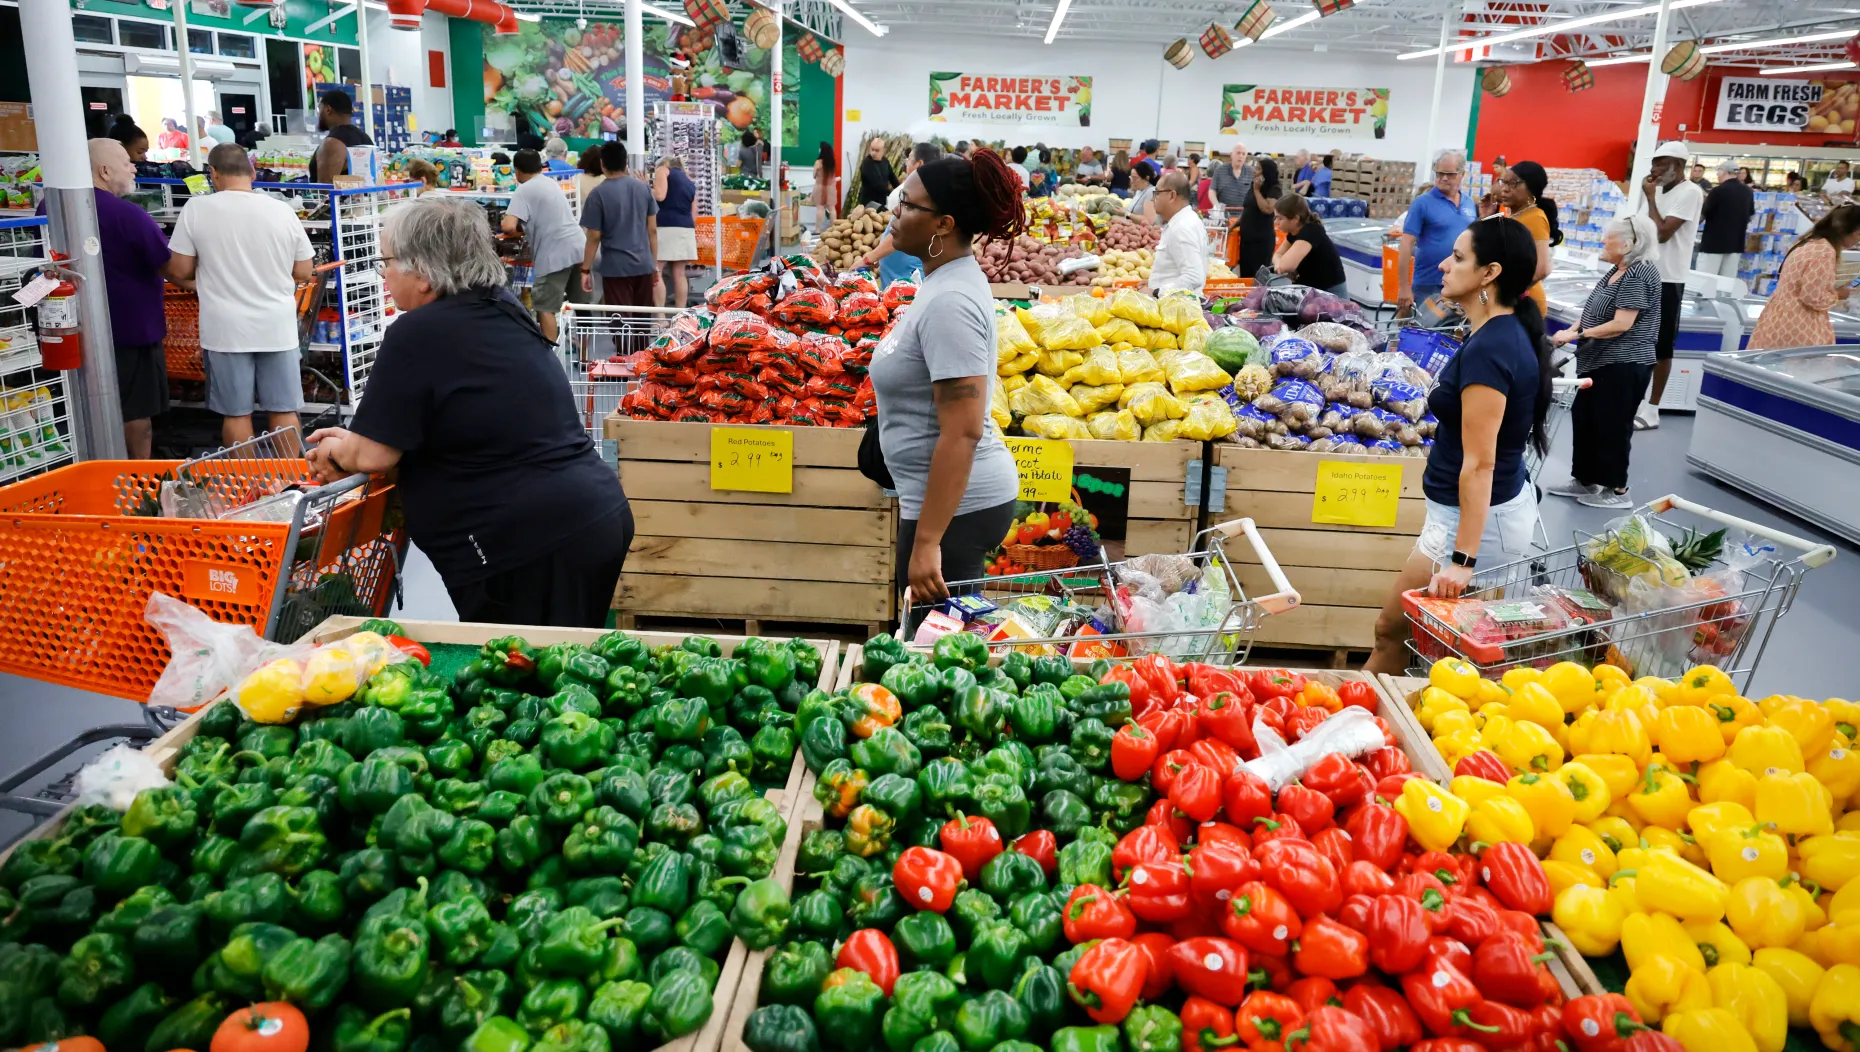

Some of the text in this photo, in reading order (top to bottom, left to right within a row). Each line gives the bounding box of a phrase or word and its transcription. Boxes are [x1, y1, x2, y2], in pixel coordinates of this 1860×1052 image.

[960, 76, 1061, 95] FARMER'S
[1727, 82, 1822, 102] FARM FRESH
[949, 92, 1071, 112] MARKET
[1254, 89, 1357, 107] FARMER'S
[962, 111, 987, 119] Fresh
[990, 112, 1022, 121] Locally
[1241, 105, 1366, 124] MARKET
[1727, 103, 1809, 126] EGGS
[1254, 124, 1351, 135] Fresh Locally Grown
[718, 461, 723, 469] $
[1354, 473, 1387, 481] Potatoes
[1321, 495, 1327, 503] $
[208, 568, 236, 583] BIG
[209, 577, 239, 594] LOTS!
